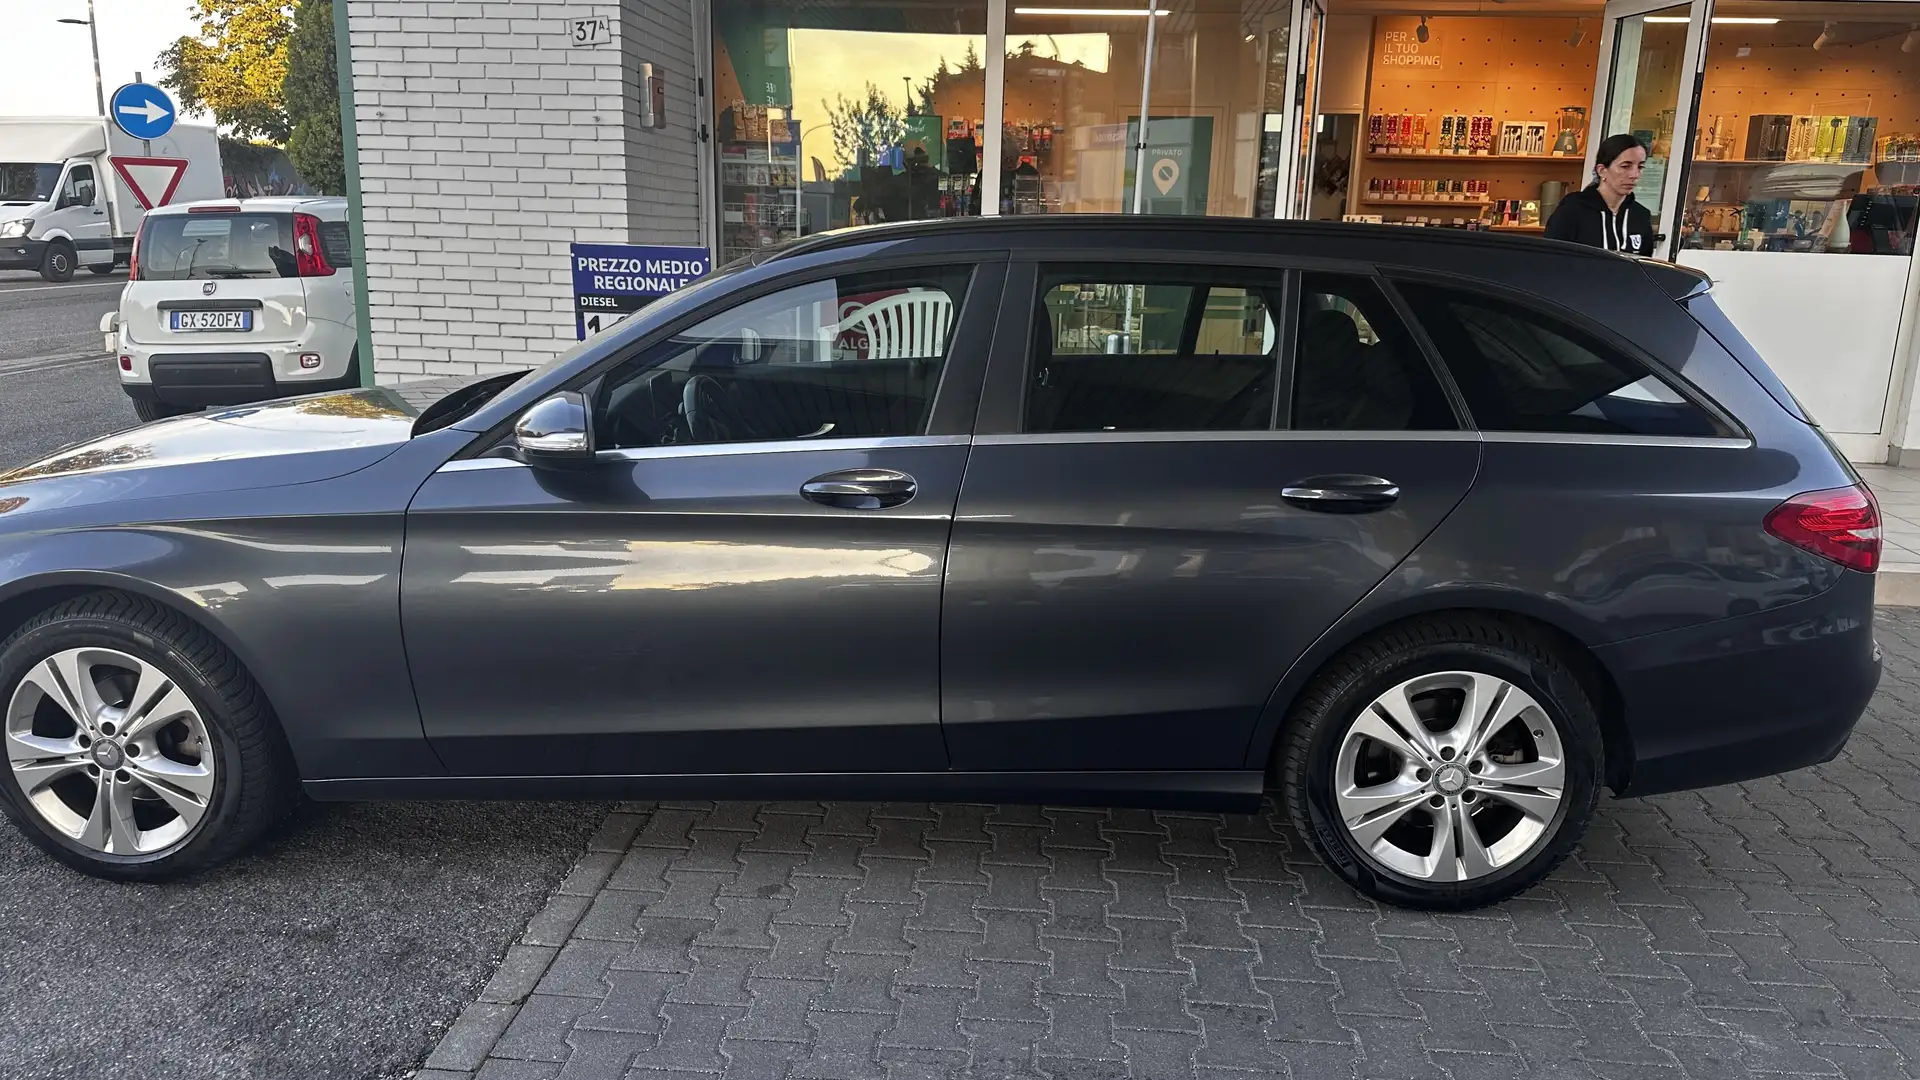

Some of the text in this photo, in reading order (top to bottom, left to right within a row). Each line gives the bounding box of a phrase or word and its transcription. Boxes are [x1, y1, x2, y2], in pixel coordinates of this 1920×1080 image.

[1385, 31, 1407, 42] PER
[1384, 43, 1419, 54] IL TUO
[1382, 54, 1440, 66] SHOPPING
[577, 257, 703, 276] PREZZO MEDIO
[580, 296, 618, 307] DIESEL
[181, 312, 197, 328] GX
[200, 312, 242, 328] 520FX
